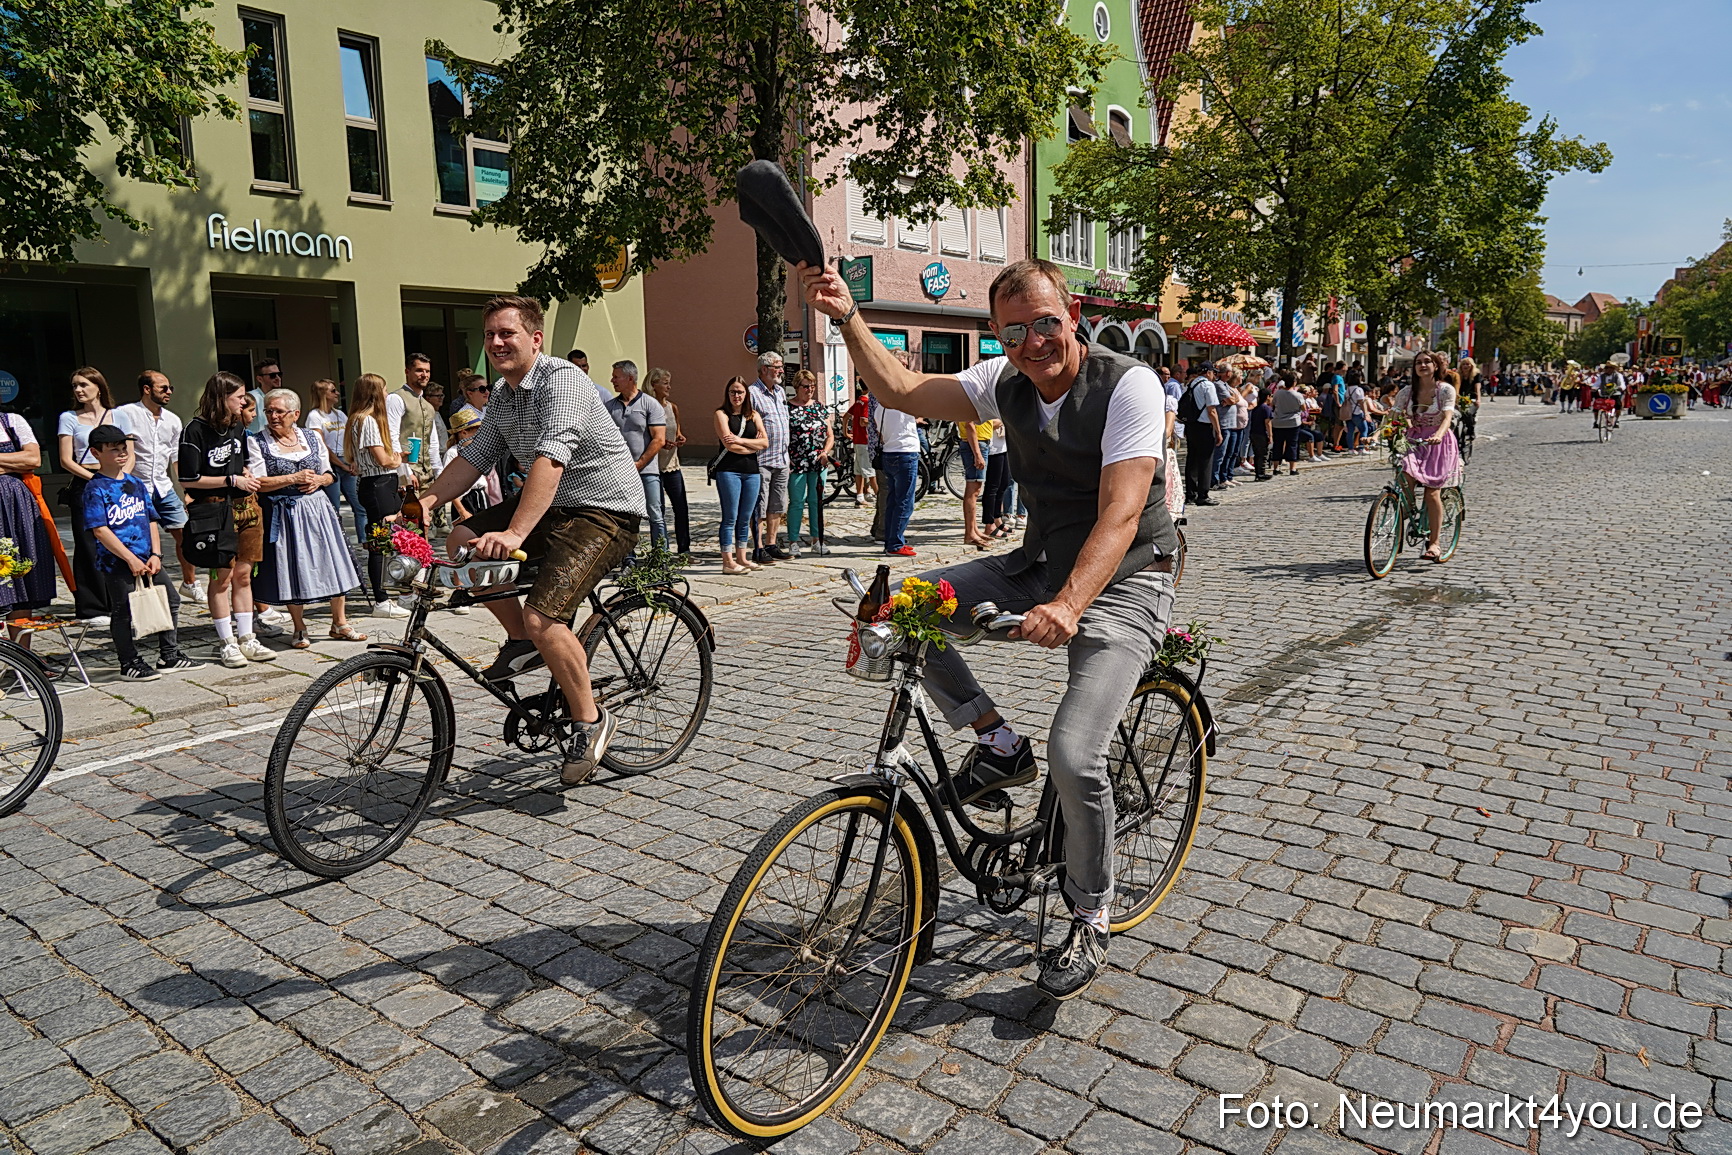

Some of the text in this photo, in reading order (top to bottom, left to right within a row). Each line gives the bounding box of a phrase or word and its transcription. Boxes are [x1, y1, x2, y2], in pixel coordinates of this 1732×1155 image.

[481, 176, 507, 186] Bauleitung
[846, 265, 857, 274] vom
[850, 267, 867, 280] FASS
[922, 266, 938, 279] vom
[927, 273, 950, 293] FASS
[887, 336, 905, 348] Whisky
